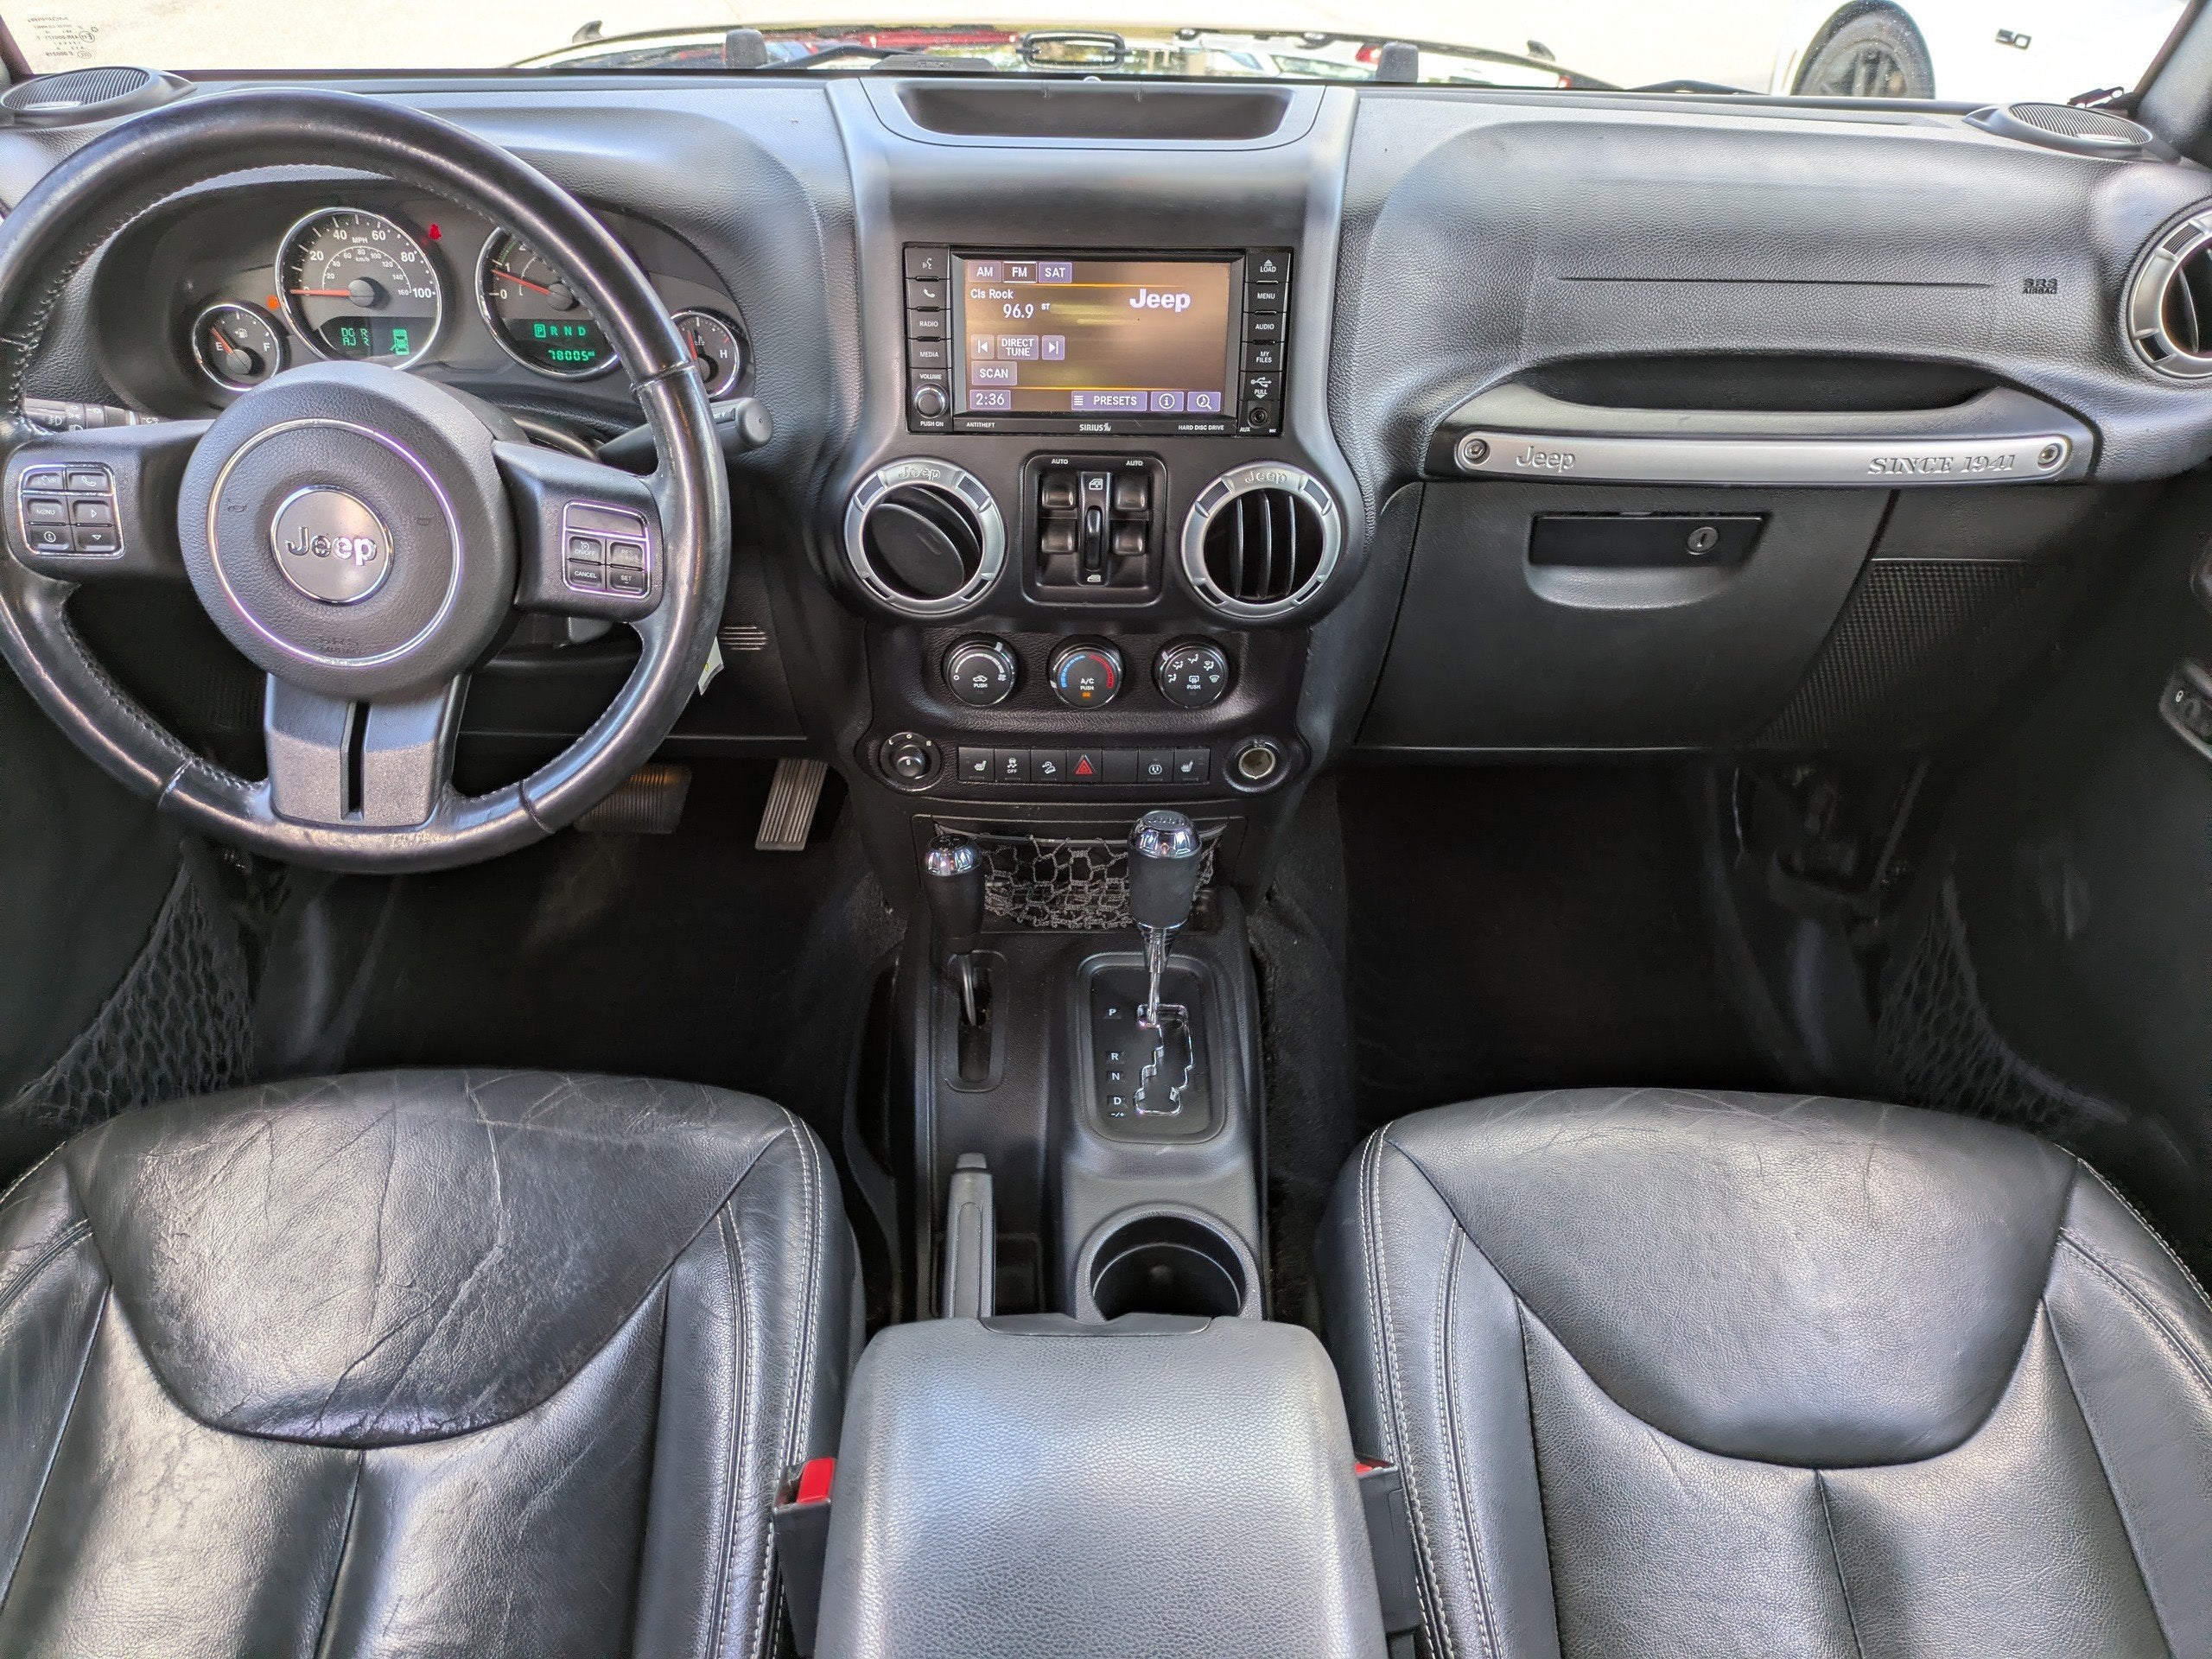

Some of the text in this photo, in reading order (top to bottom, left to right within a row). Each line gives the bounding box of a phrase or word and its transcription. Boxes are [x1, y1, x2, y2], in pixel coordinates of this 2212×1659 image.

[333, 230, 346, 240] 40
[372, 230, 386, 240] 60
[309, 251, 324, 261] 20
[401, 251, 415, 262] 80
[976, 266, 994, 276] AM
[1012, 266, 1027, 277] FM
[1045, 267, 1065, 277] SAT
[412, 288, 432, 298] 100
[500, 289, 507, 299] 0
[988, 288, 1014, 299] Rock
[1129, 288, 1192, 312] Jeep
[1002, 303, 1034, 319] 96.9
[537, 326, 586, 336] P R N D
[263, 342, 270, 353] F
[1001, 338, 1034, 347] DIRECT
[548, 349, 588, 361] 78005
[720, 349, 728, 359] H
[1006, 346, 1031, 357] TUNE
[979, 368, 1008, 378] SCAN
[976, 393, 1005, 406] 2:36
[1093, 396, 1137, 405] PRESETS
[1516, 446, 1576, 473] Jeep
[1867, 454, 2016, 474] SINCE 1941
[898, 467, 941, 480] Jeep
[1244, 471, 1287, 485] Jeep
[285, 526, 377, 566] Jeep
[574, 570, 597, 579] CANCEL
